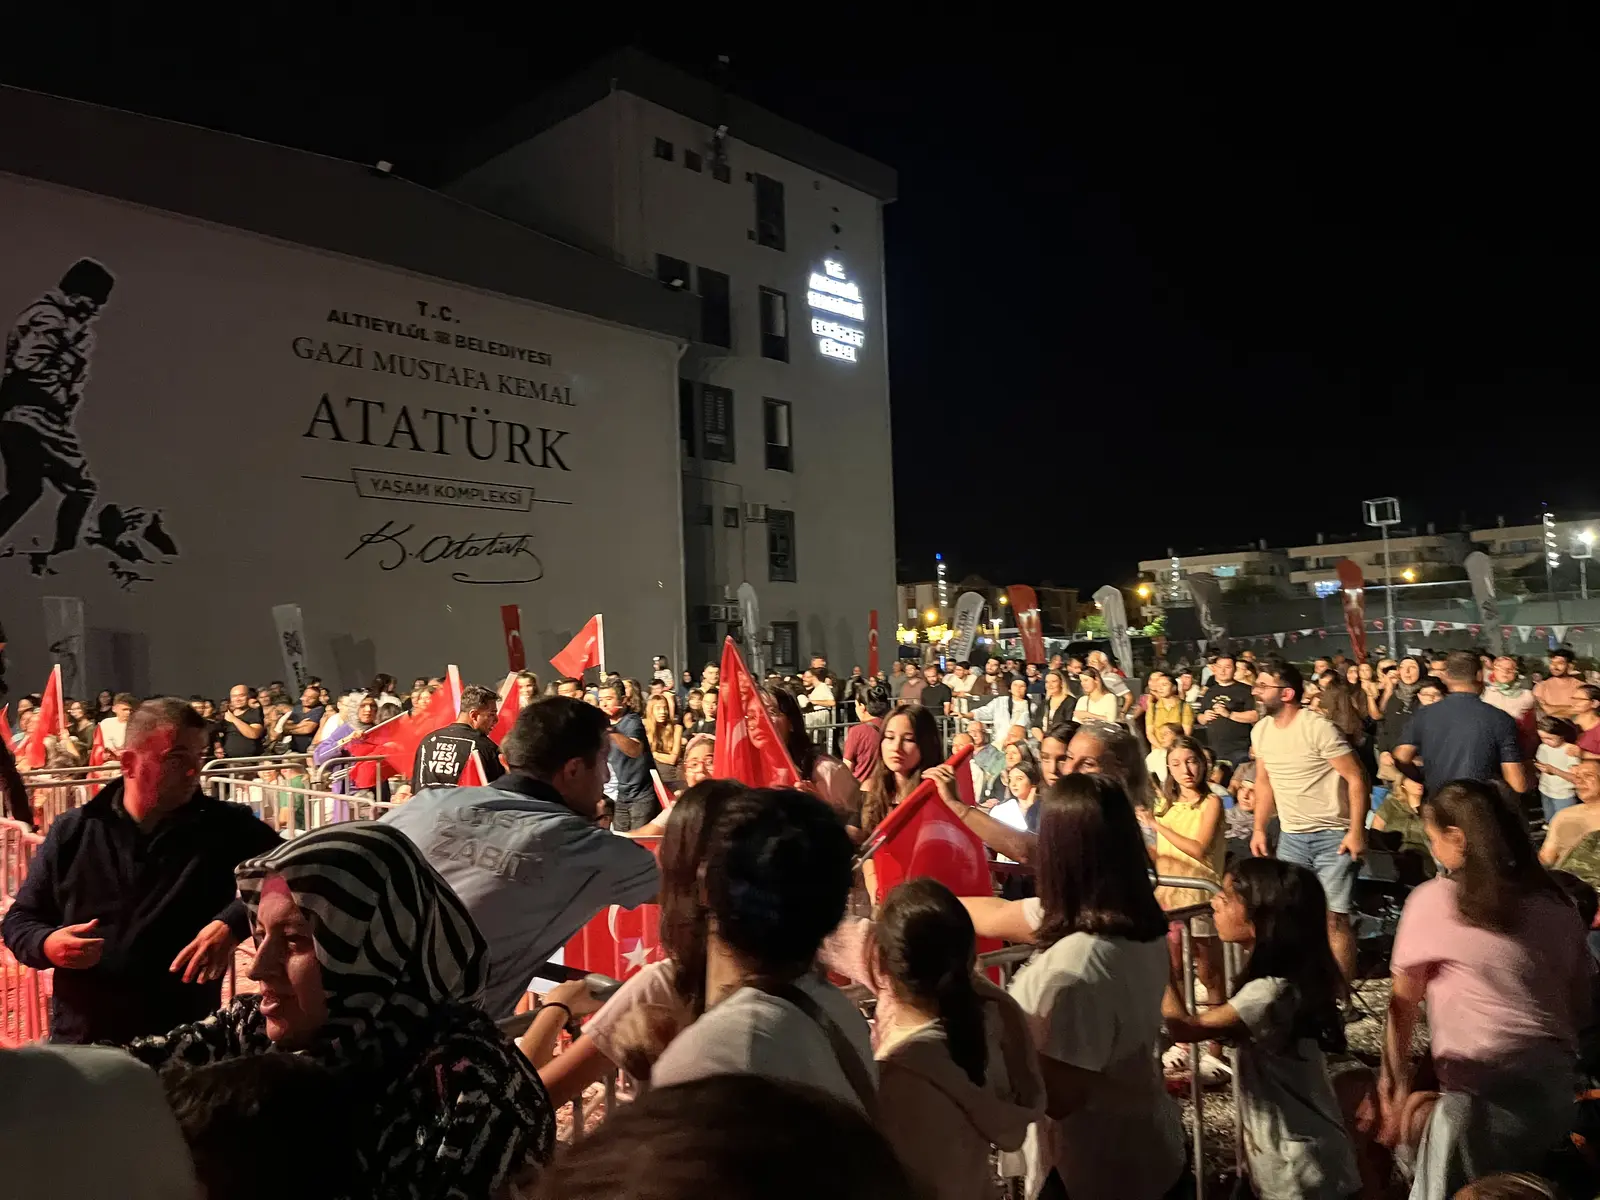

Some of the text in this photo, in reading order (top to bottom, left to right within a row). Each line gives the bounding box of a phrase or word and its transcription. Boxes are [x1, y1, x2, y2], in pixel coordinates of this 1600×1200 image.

[416, 300, 461, 323] T.C.
[292, 336, 577, 407] GAZİ MUSTAFA KEMAL
[302, 392, 572, 471] ATATÜRK
[432, 750, 458, 764] YES!
[436, 742, 457, 753] YES!
[428, 760, 460, 777] YES!
